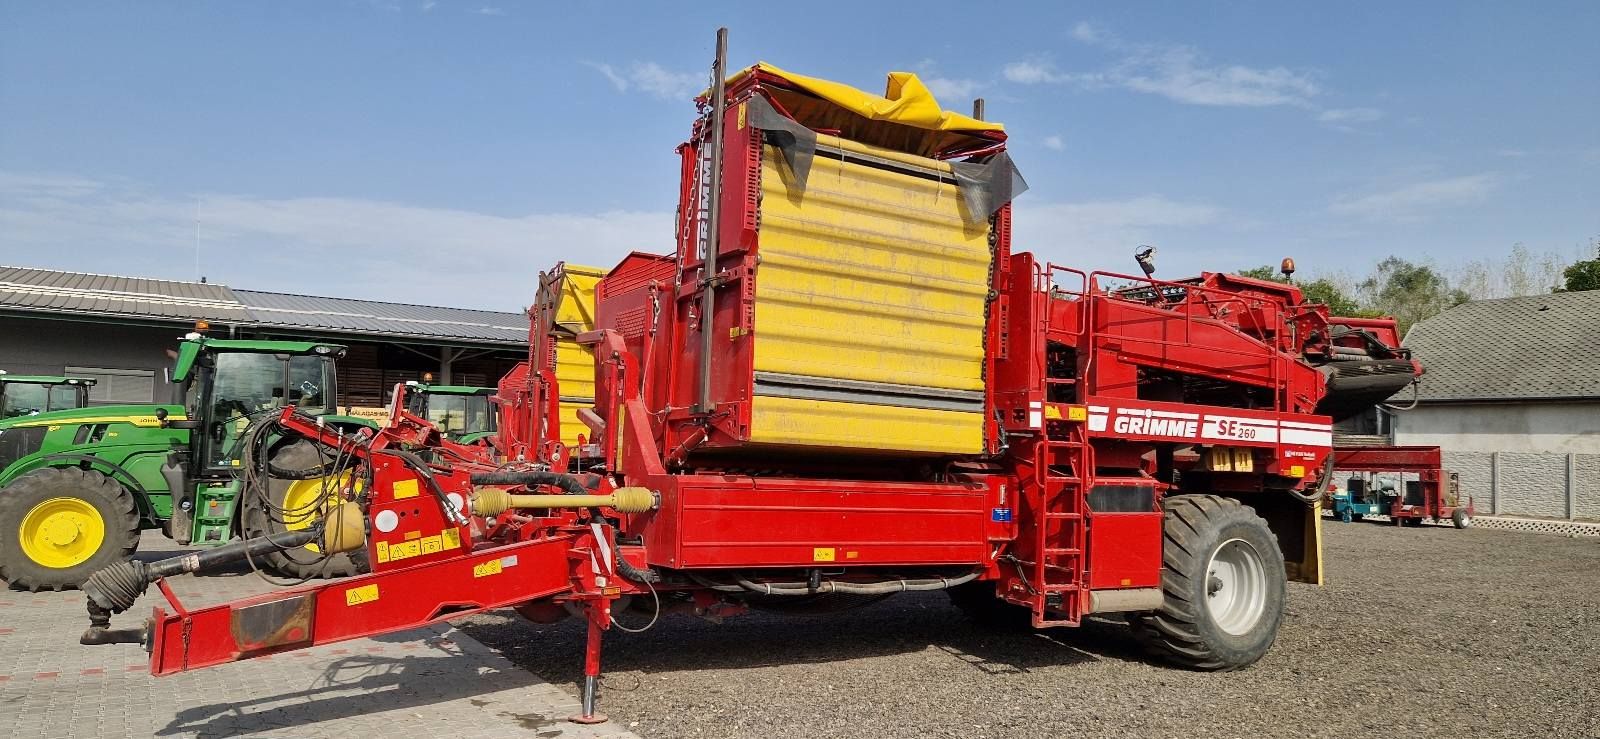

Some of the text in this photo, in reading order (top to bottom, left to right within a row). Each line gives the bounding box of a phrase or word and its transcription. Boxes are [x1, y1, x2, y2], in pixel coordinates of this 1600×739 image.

[698, 142, 712, 260] GRIMME
[1114, 409, 1198, 438] GRIMME
[1217, 420, 1256, 440] SE 260
